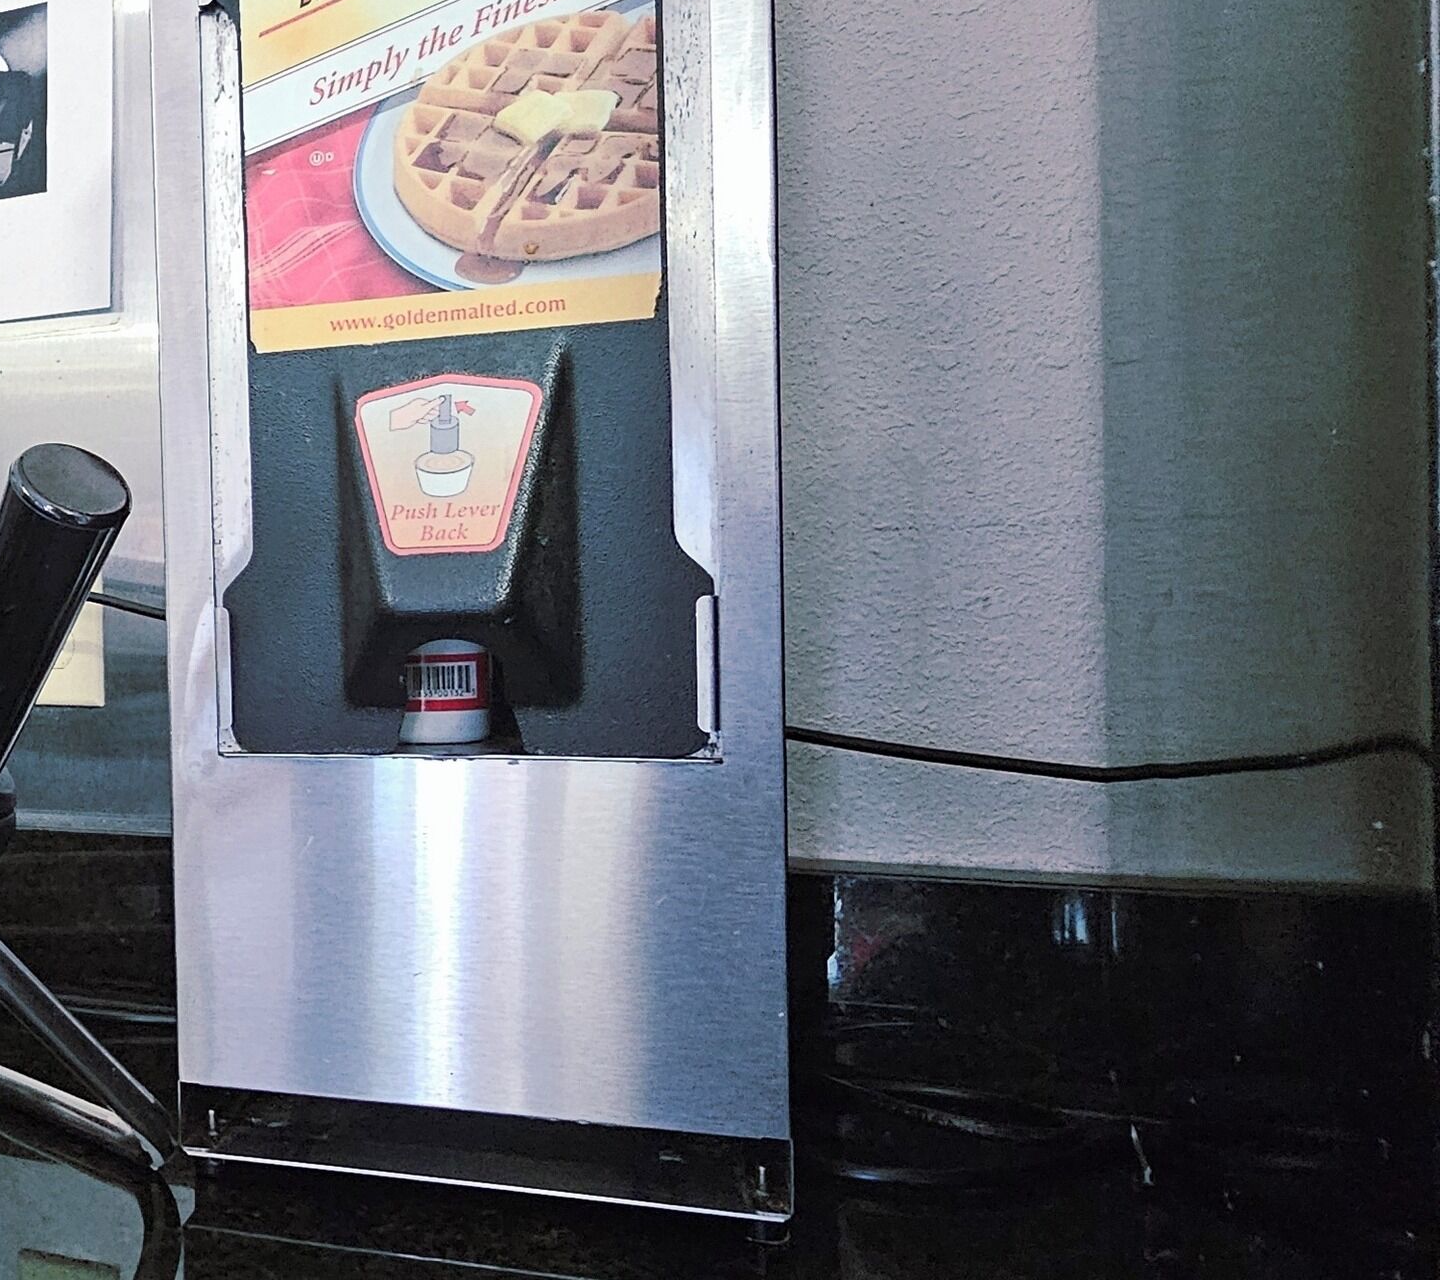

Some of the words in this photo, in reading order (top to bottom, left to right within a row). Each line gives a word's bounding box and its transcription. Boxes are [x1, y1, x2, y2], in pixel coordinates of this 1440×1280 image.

[309, 45, 410, 106] Simply
[417, 25, 464, 61] the
[329, 298, 566, 332] www.goldenmalted.com
[390, 502, 437, 520] Push
[444, 502, 500, 518] Lever
[420, 523, 469, 541] Back
